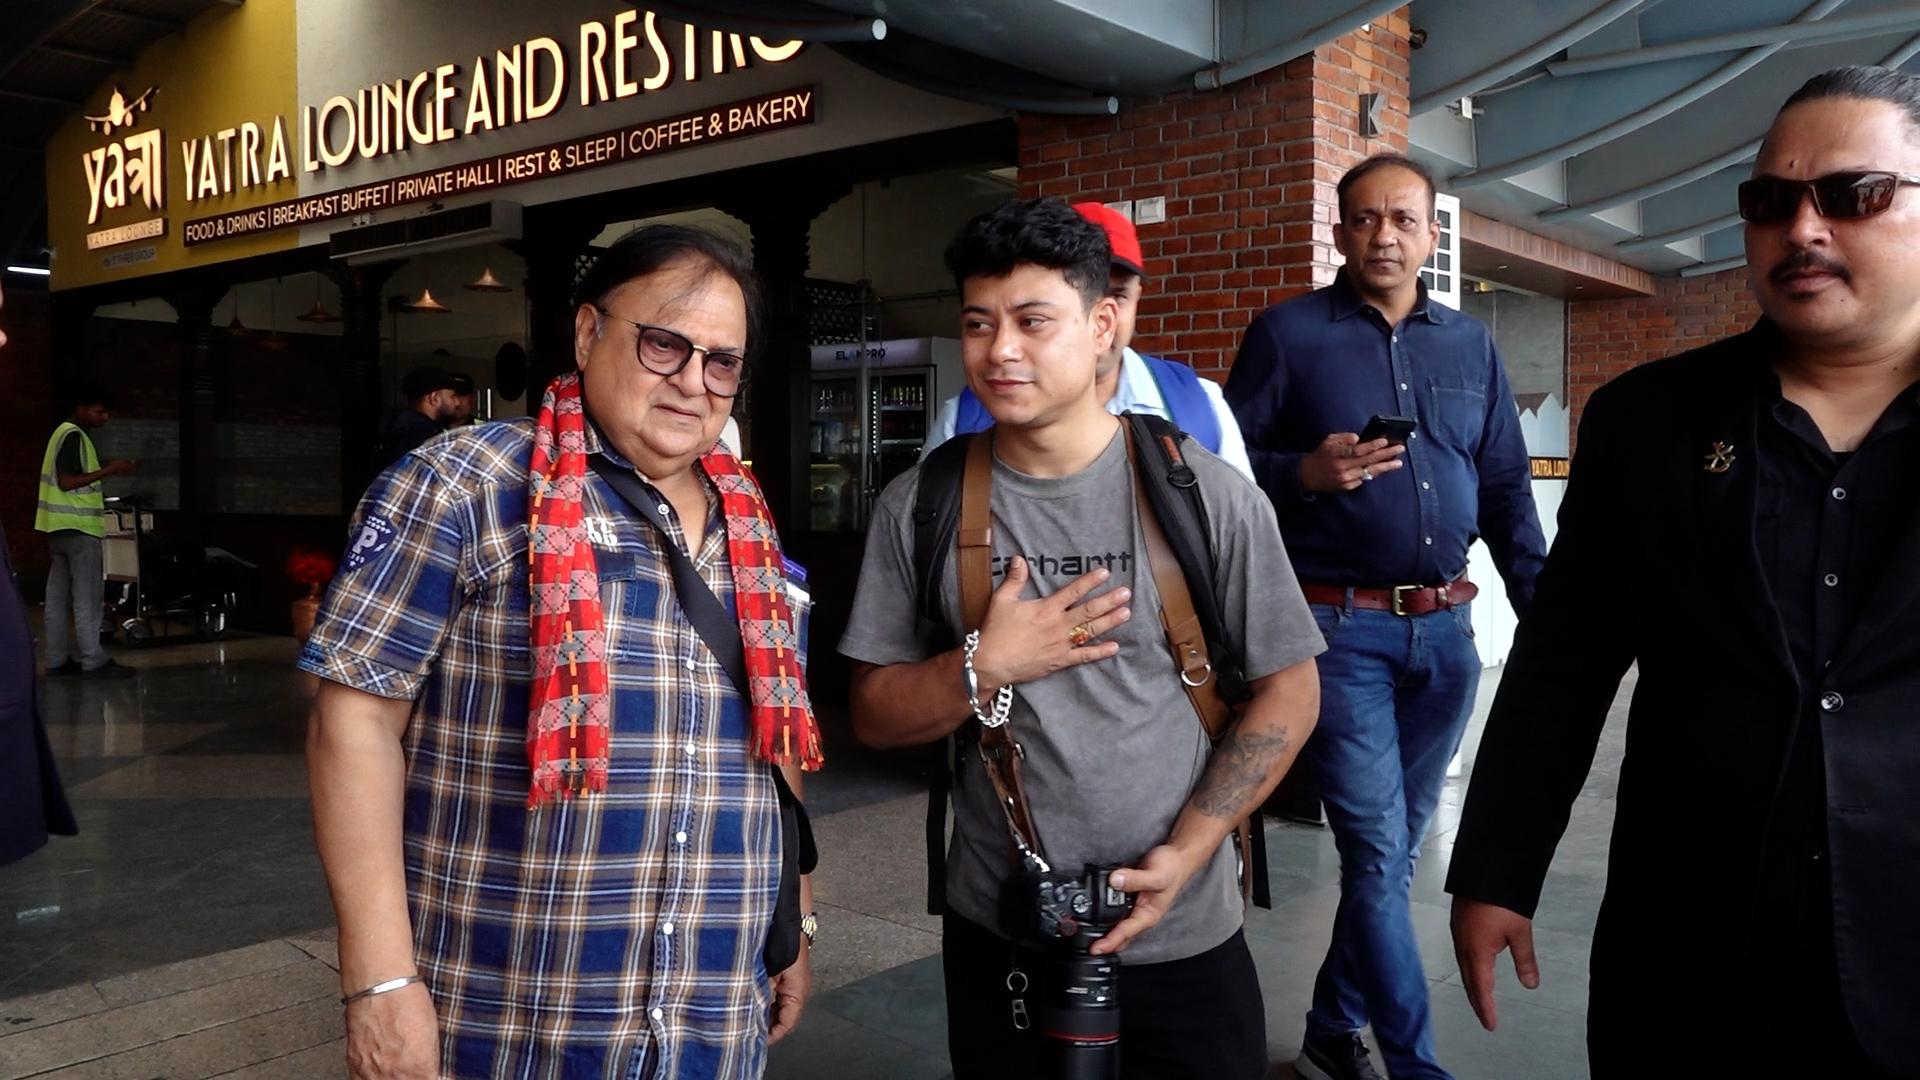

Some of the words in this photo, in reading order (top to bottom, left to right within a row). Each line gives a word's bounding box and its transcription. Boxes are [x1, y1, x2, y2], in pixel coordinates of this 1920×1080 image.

[182, 115, 290, 201] YATRA
[304, 63, 455, 172] LOUNGE
[465, 37, 565, 135] AND
[186, 221, 216, 242] FOOD
[216, 219, 226, 237] &
[226, 210, 267, 235] DRINKS
[273, 195, 340, 226] BREAKFAST
[341, 185, 390, 213] BUFFET
[398, 171, 454, 201] PRIVATE
[456, 163, 495, 190] HALL
[505, 152, 546, 180] REST
[548, 148, 562, 172] &
[565, 136, 617, 168] SLEEP
[629, 116, 704, 154] COFFEE
[708, 112, 723, 137] &
[728, 91, 812, 133] BAKERY
